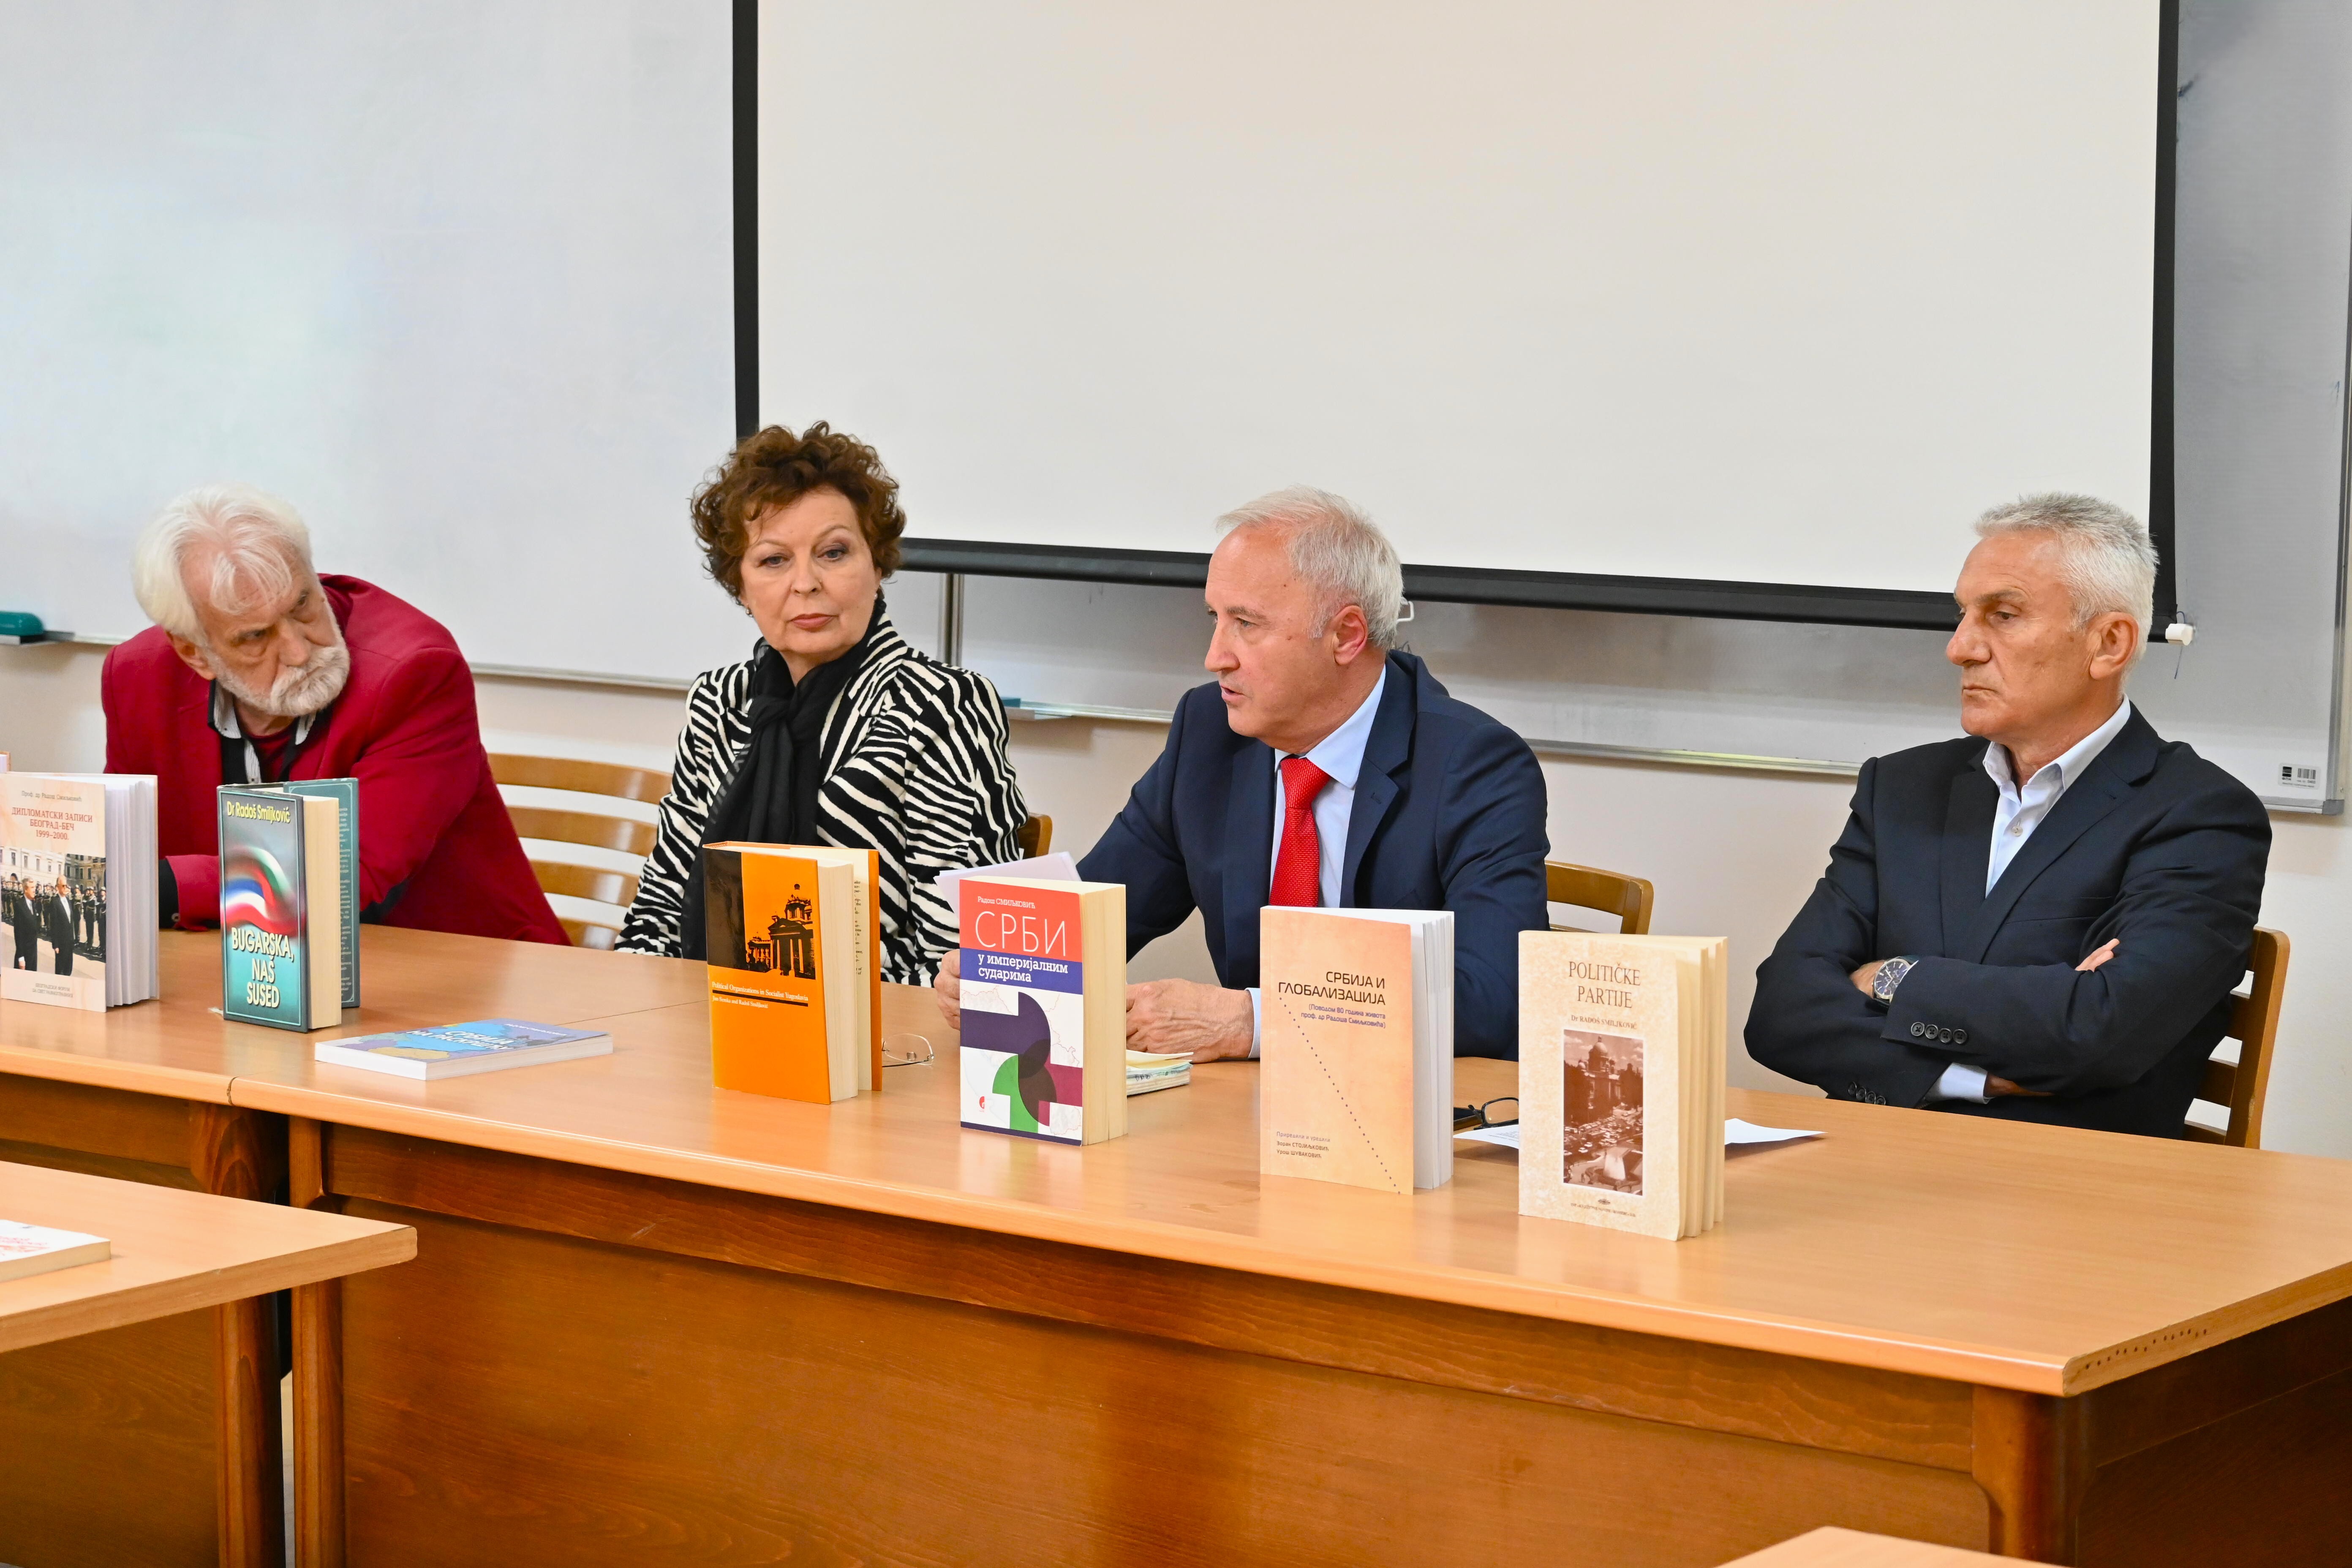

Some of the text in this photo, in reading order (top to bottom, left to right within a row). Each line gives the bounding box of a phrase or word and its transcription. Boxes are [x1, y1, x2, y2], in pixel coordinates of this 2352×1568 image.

[12, 807, 93, 822] ДИПЛОМАТСКИ ЗАПИСИ
[227, 801, 291, 824] Dr Radoš Smiljković
[977, 896, 1036, 909] Радош СМИЉКОВИЋ
[975, 911, 1066, 956] СРБИ
[231, 927, 294, 962] BUGARSKA,
[252, 955, 275, 983] NAŠ
[978, 954, 1068, 974] у империјалним
[1569, 961, 1641, 986] POLITIČKE
[978, 967, 1032, 983] сударима
[1326, 971, 1385, 989] СРБИЈА И
[247, 982, 280, 1008] SUSED
[712, 981, 728, 990] Political
[730, 984, 759, 994] Organizations
[785, 992, 808, 1001] Yugoslavia
[1279, 982, 1386, 1005] ГЛОБАЛИЗАЦИЈА
[1577, 985, 1633, 1009] PARTIJE
[1309, 1004, 1336, 1013] (Поводом
[1301, 1013, 1317, 1021] проф.
[1326, 1015, 1347, 1023] Радоша
[1348, 1018, 1386, 1029] Смиљковића)
[1580, 1016, 1600, 1024] RADOŠ
[445, 1031, 514, 1044] СРБИЈА
[1277, 1131, 1305, 1139] Приредили
[1292, 1142, 1329, 1151] СТОЈИЉКОВИЋ
